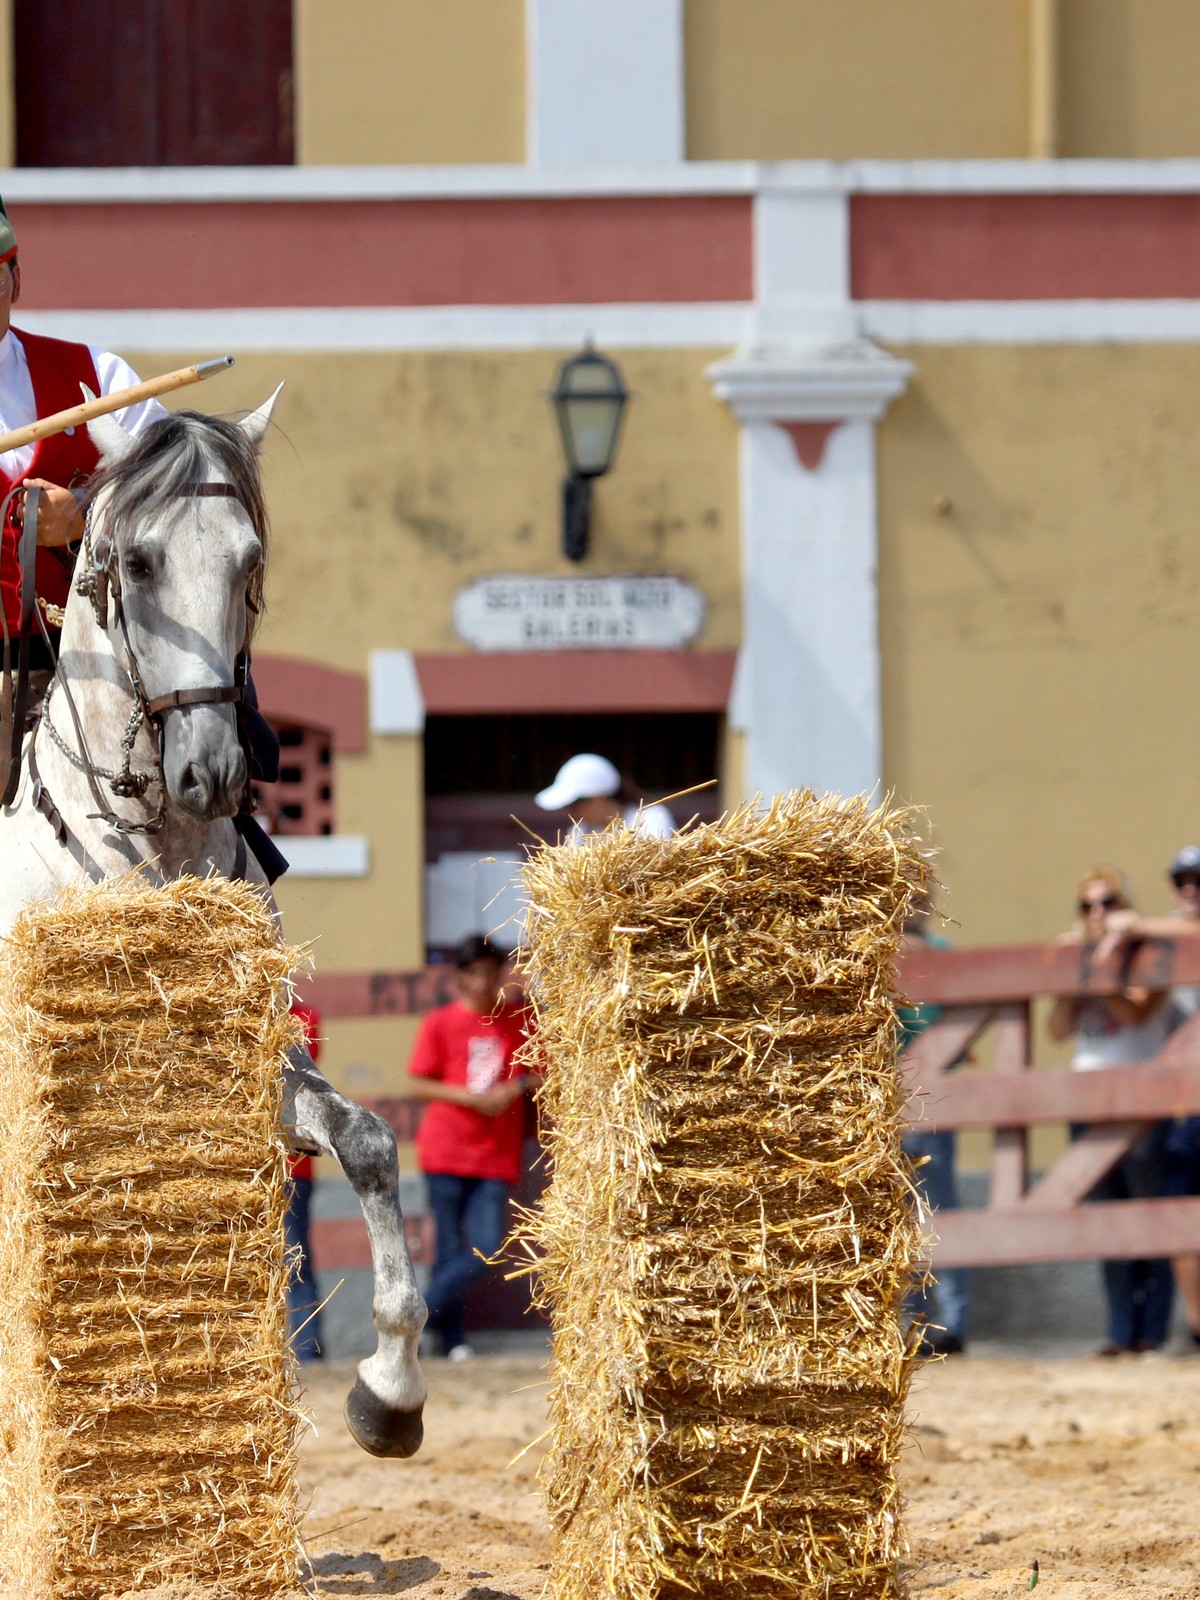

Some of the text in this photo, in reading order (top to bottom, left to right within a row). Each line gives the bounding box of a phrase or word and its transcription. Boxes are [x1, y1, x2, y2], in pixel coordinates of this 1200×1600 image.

[484, 582, 566, 609] SECTOR
[573, 582, 613, 608] SOL
[523, 610, 634, 638] GALERIAS
